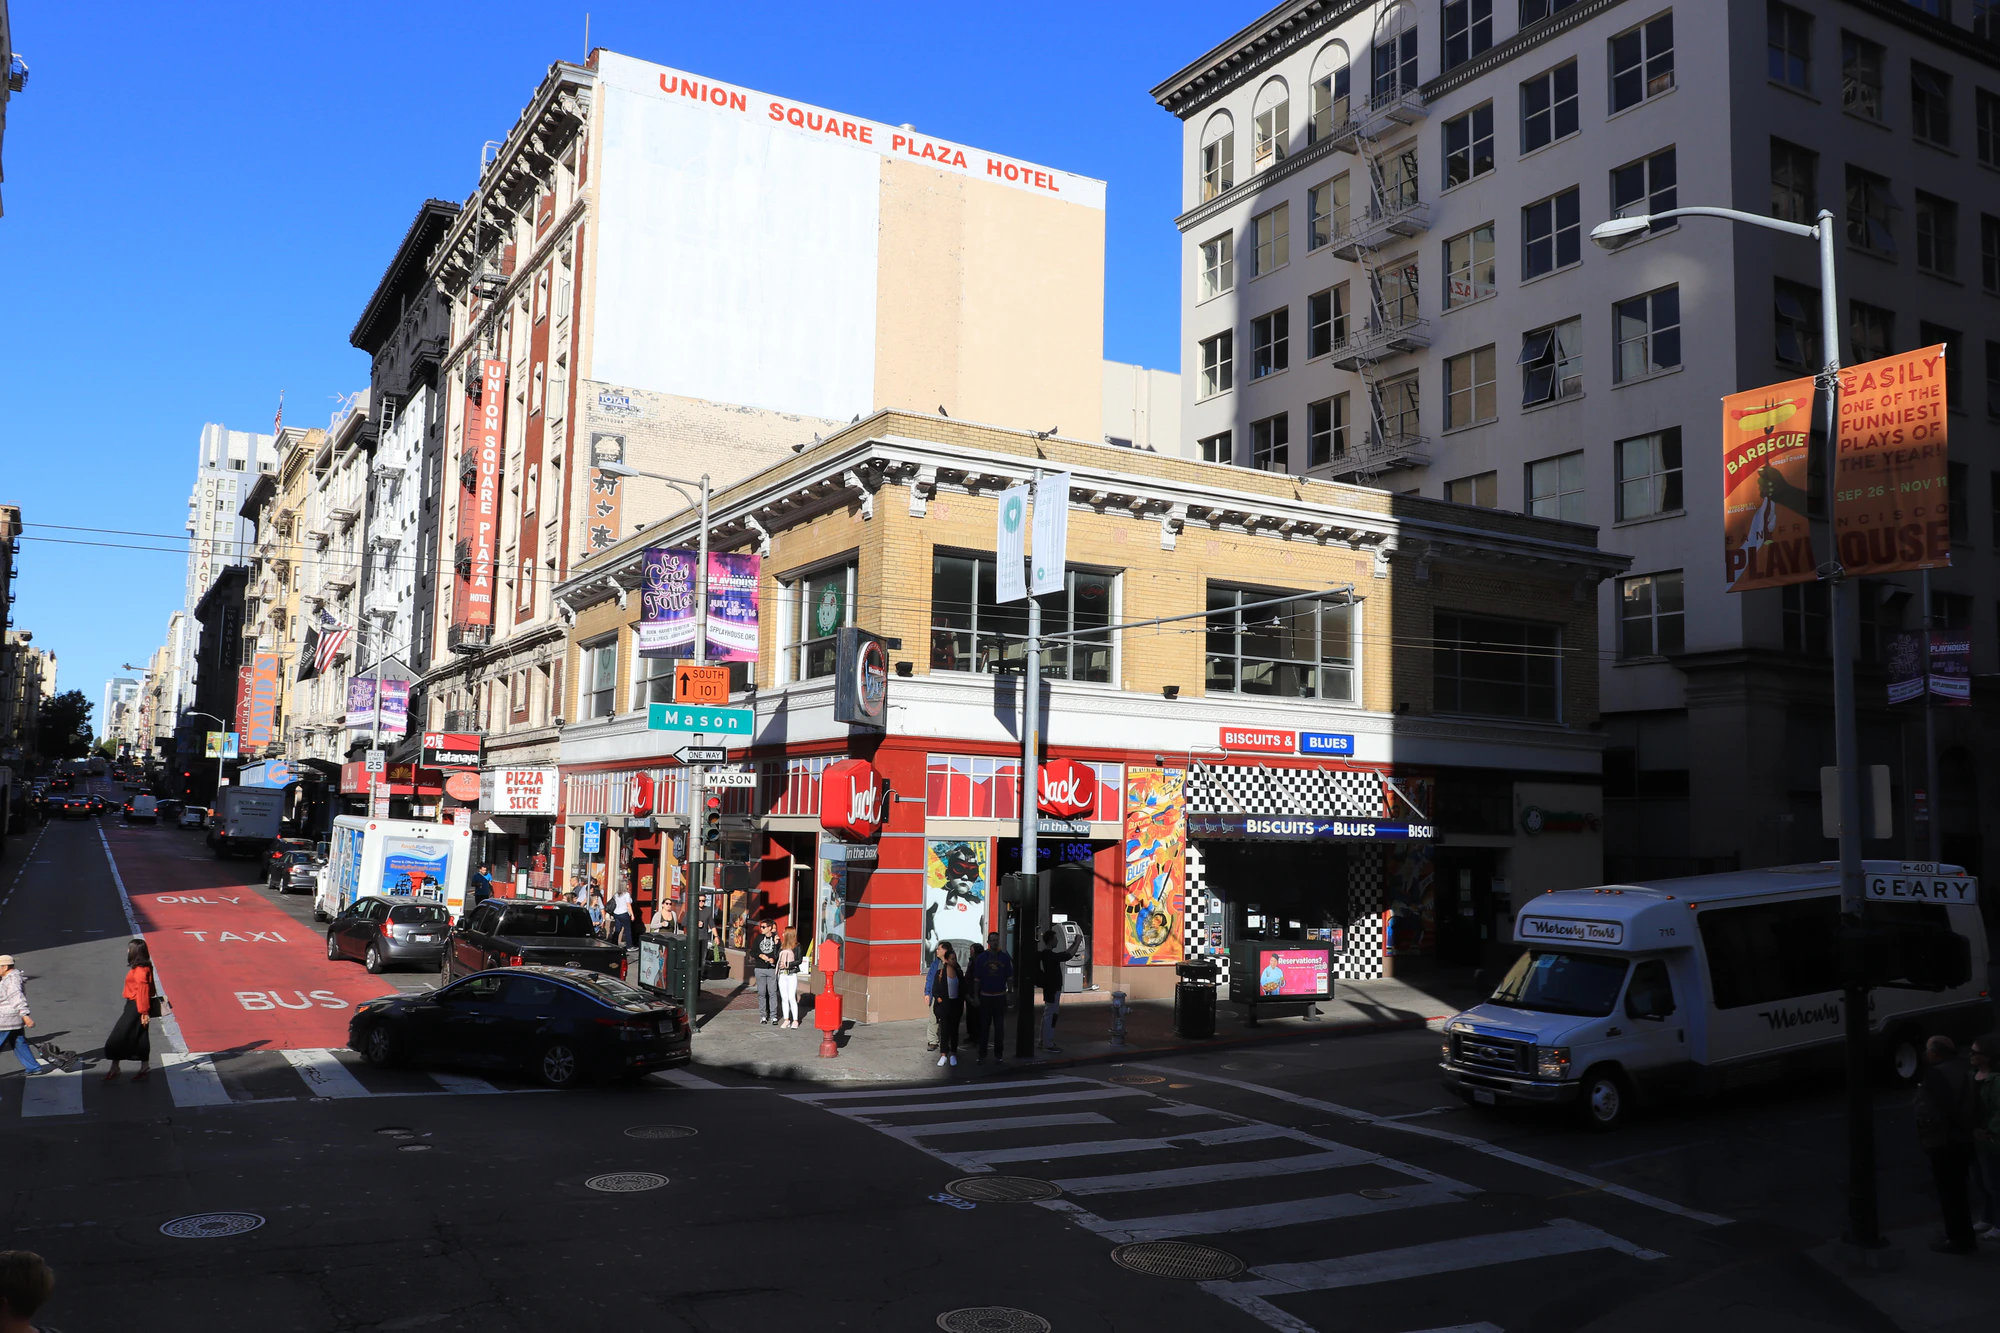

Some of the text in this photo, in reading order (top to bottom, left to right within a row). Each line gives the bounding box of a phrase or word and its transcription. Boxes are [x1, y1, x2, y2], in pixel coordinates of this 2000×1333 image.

[659, 73, 1060, 192] UNION SQUARE PLAZA HOTEL
[1843, 356, 1940, 397] EASILY
[600, 395, 628, 405] TOTAL
[1841, 384, 1941, 415] ONE OF THE
[1841, 402, 1941, 434] FUNNIEST
[1840, 421, 1941, 453] PLAYS OF
[1726, 433, 1807, 475] BARBECUE
[1840, 453, 1876, 472] THE
[1883, 442, 1941, 465] YEAR!
[475, 365, 500, 588] UNION SQUARE PLAZA
[1837, 488, 1863, 502] SEP
[1867, 484, 1885, 497] 26
[1900, 479, 1931, 493] NOV
[1937, 476, 1947, 487] 11
[206, 478, 215, 531] HOTEL
[1726, 531, 1764, 545] SAN
[1836, 519, 1950, 569] OUSE
[661, 554, 680, 573] La
[708, 576, 759, 588] PLAYHOUSE
[470, 592, 491, 603] HOTEL
[644, 589, 695, 619] Folles
[710, 599, 729, 608] JULY
[726, 608, 757, 617] SEPT 16
[224, 613, 236, 666] WARWICK
[709, 625, 756, 641] SFPLAYHOUSE.ORG
[1930, 643, 1970, 652] PLAYHOUSE
[693, 669, 724, 679] SOUTH
[700, 685, 717, 697] 101
[251, 657, 275, 741] DAVID'S
[665, 710, 738, 728] Mason
[423, 735, 444, 749] 刀屋
[1225, 733, 1293, 746] BISCUITS &
[1309, 737, 1348, 749] BLUES
[435, 750, 478, 765] katanaya
[367, 762, 382, 770] 25
[505, 771, 543, 785] PIZZA
[709, 775, 752, 784] MASON
[507, 787, 542, 795] BY THE
[1038, 766, 1093, 808] Jack
[509, 796, 539, 809] SLICE
[847, 771, 882, 825] Jack
[1039, 822, 1090, 833] in the box
[1246, 819, 1315, 834] BISCUITS
[1318, 823, 1329, 832] AND
[1333, 822, 1376, 837] BLUES
[845, 846, 878, 859] in the box
[1059, 843, 1092, 861] 1995
[1914, 863, 1933, 872] 400
[1872, 878, 1970, 899] GEARY
[156, 895, 241, 904] ONLY
[183, 931, 288, 942] TAXI
[1530, 920, 1616, 939] Mercury Tours
[1659, 928, 1675, 937] 710
[1278, 956, 1323, 965] Reservations?
[233, 990, 350, 1011] BUS
[1759, 1003, 1841, 1030] Mercury
